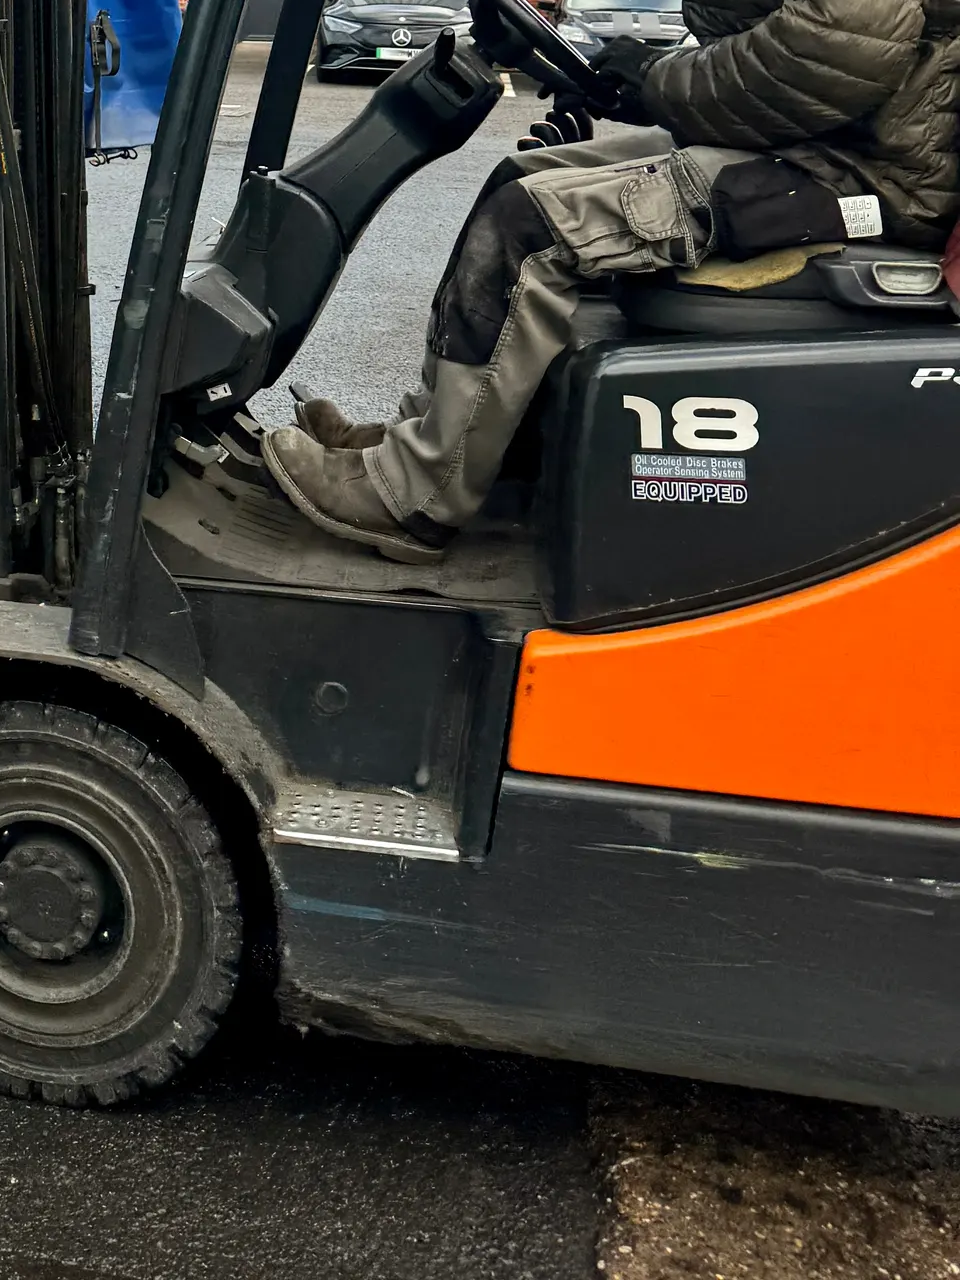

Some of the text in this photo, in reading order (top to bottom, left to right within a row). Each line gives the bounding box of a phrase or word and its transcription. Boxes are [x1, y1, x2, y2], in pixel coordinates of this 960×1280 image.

[910, 367, 960, 389] P
[622, 394, 760, 452] 18
[634, 454, 744, 469] Oil Cooled Disc Brakes
[635, 464, 745, 479] Operator Sensing System
[631, 480, 748, 504] EQUIPPED
